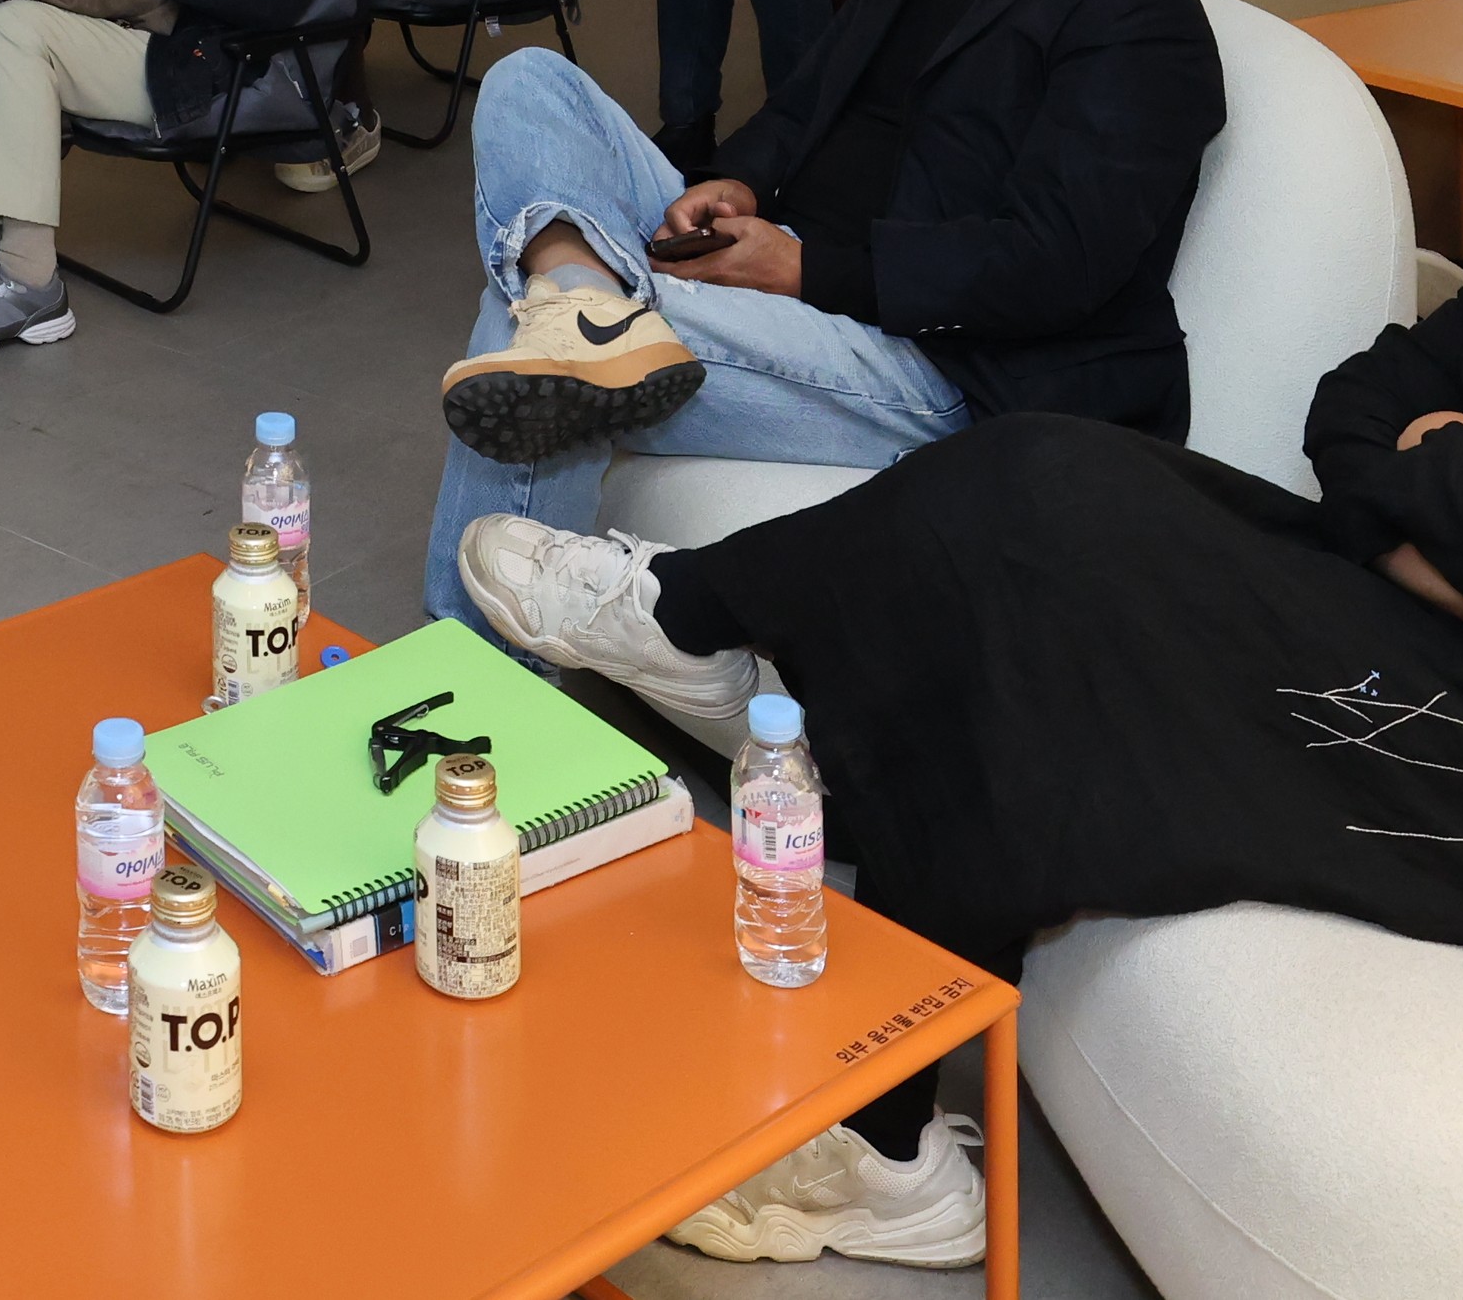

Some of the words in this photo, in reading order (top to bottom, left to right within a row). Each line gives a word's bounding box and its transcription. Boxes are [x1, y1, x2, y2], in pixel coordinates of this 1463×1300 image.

[236, 528, 272, 537] T.O.P
[446, 760, 487, 777] T.O.P
[159, 870, 202, 892] T.O.P
[186, 972, 228, 993] Maxim
[161, 995, 241, 1053] T.O.P
[836, 1041, 870, 1064] 외부
[867, 1014, 916, 1045] 음식물
[909, 994, 946, 1017] 반입
[939, 977, 975, 1000] 금지
